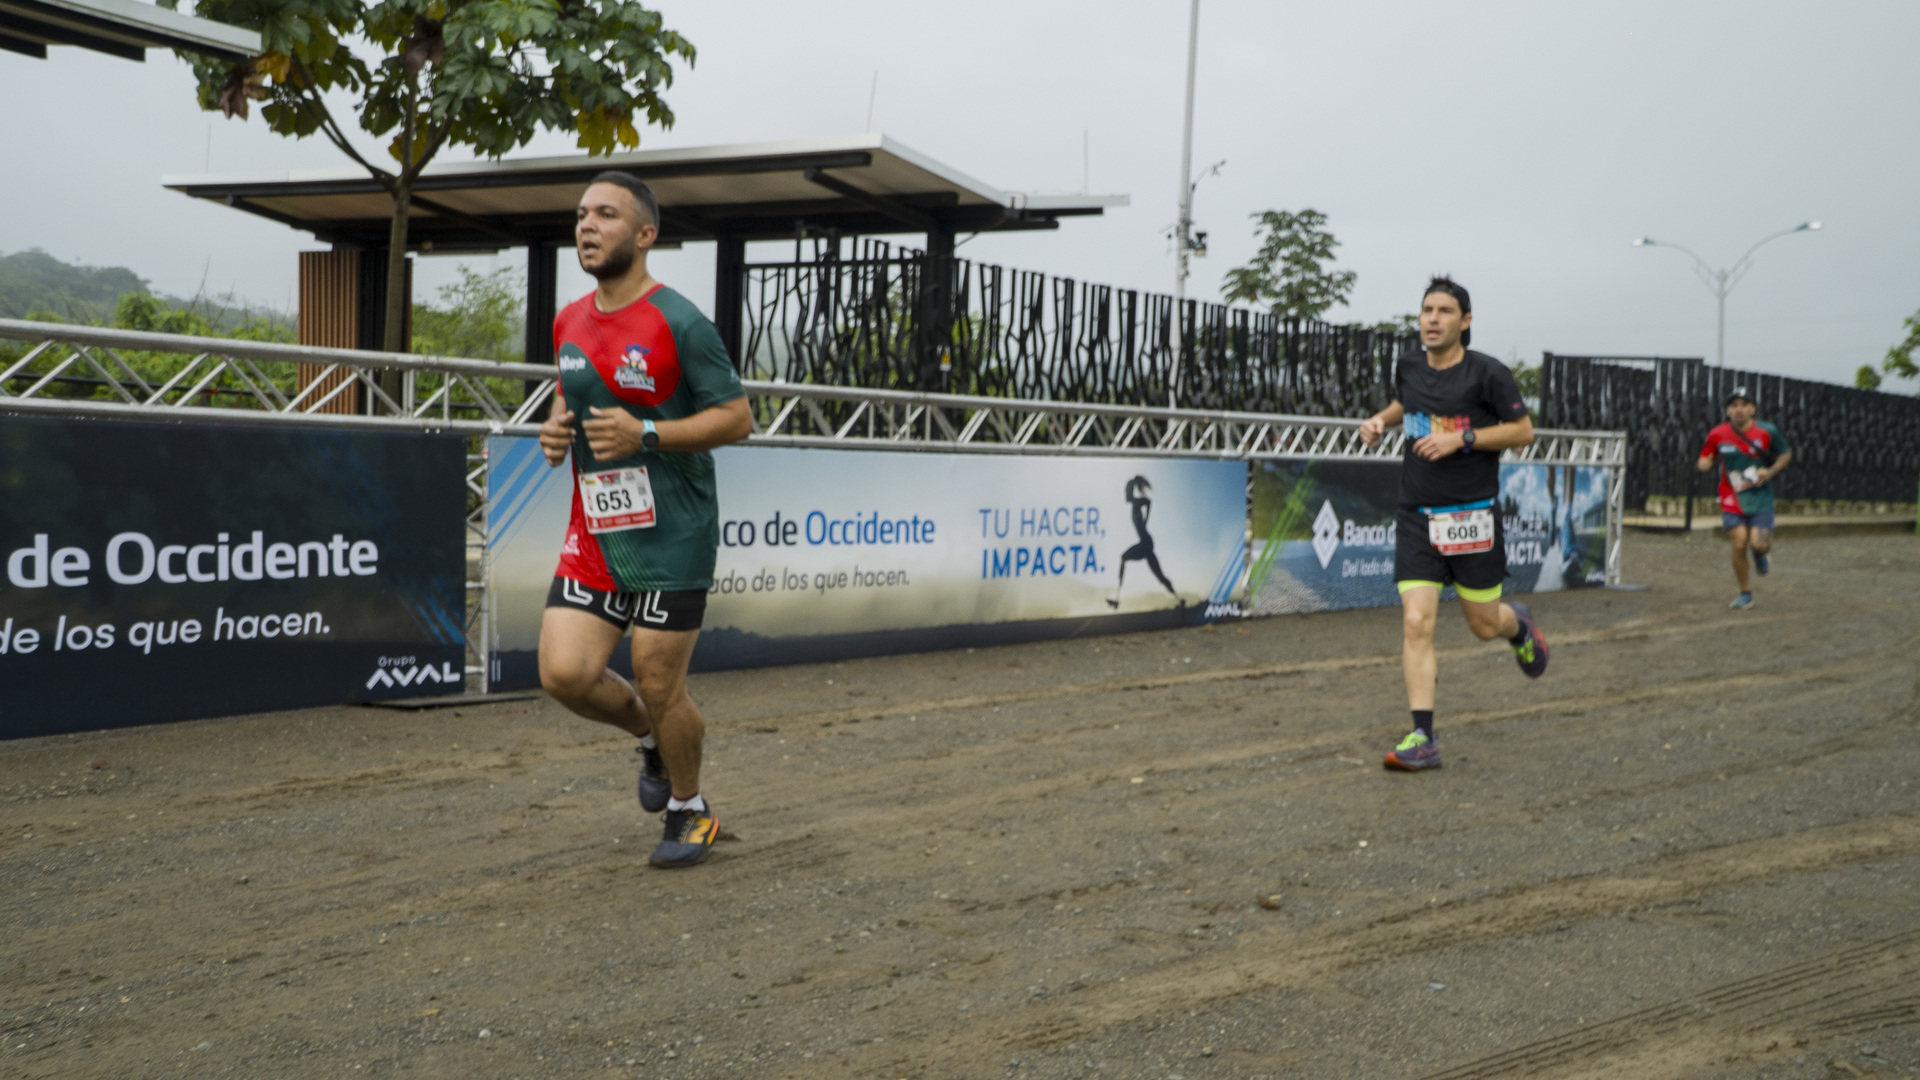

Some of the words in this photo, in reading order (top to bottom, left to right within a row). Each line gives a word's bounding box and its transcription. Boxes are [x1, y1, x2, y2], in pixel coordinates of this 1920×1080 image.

[596, 488, 632, 512] 653
[716, 520, 756, 547] co
[764, 510, 798, 546] de
[806, 510, 936, 546] Occidente
[979, 508, 1010, 538] TU
[1020, 506, 1106, 539] HACER,
[1343, 518, 1383, 548] Banco
[1447, 525, 1478, 541] 608
[7, 533, 91, 589] de
[105, 529, 379, 586] Occidente
[982, 545, 1106, 579] IMPACTA.
[708, 569, 747, 595] ado
[752, 567, 777, 593] de
[782, 566, 809, 592] los
[814, 568, 848, 596] que
[852, 564, 911, 588] hacen.
[0, 617, 40, 655] de
[54, 614, 115, 652] los
[128, 617, 202, 655] que
[213, 606, 332, 642] hacen.
[366, 661, 461, 691] AVAL
[378, 655, 416, 668] Grupo
